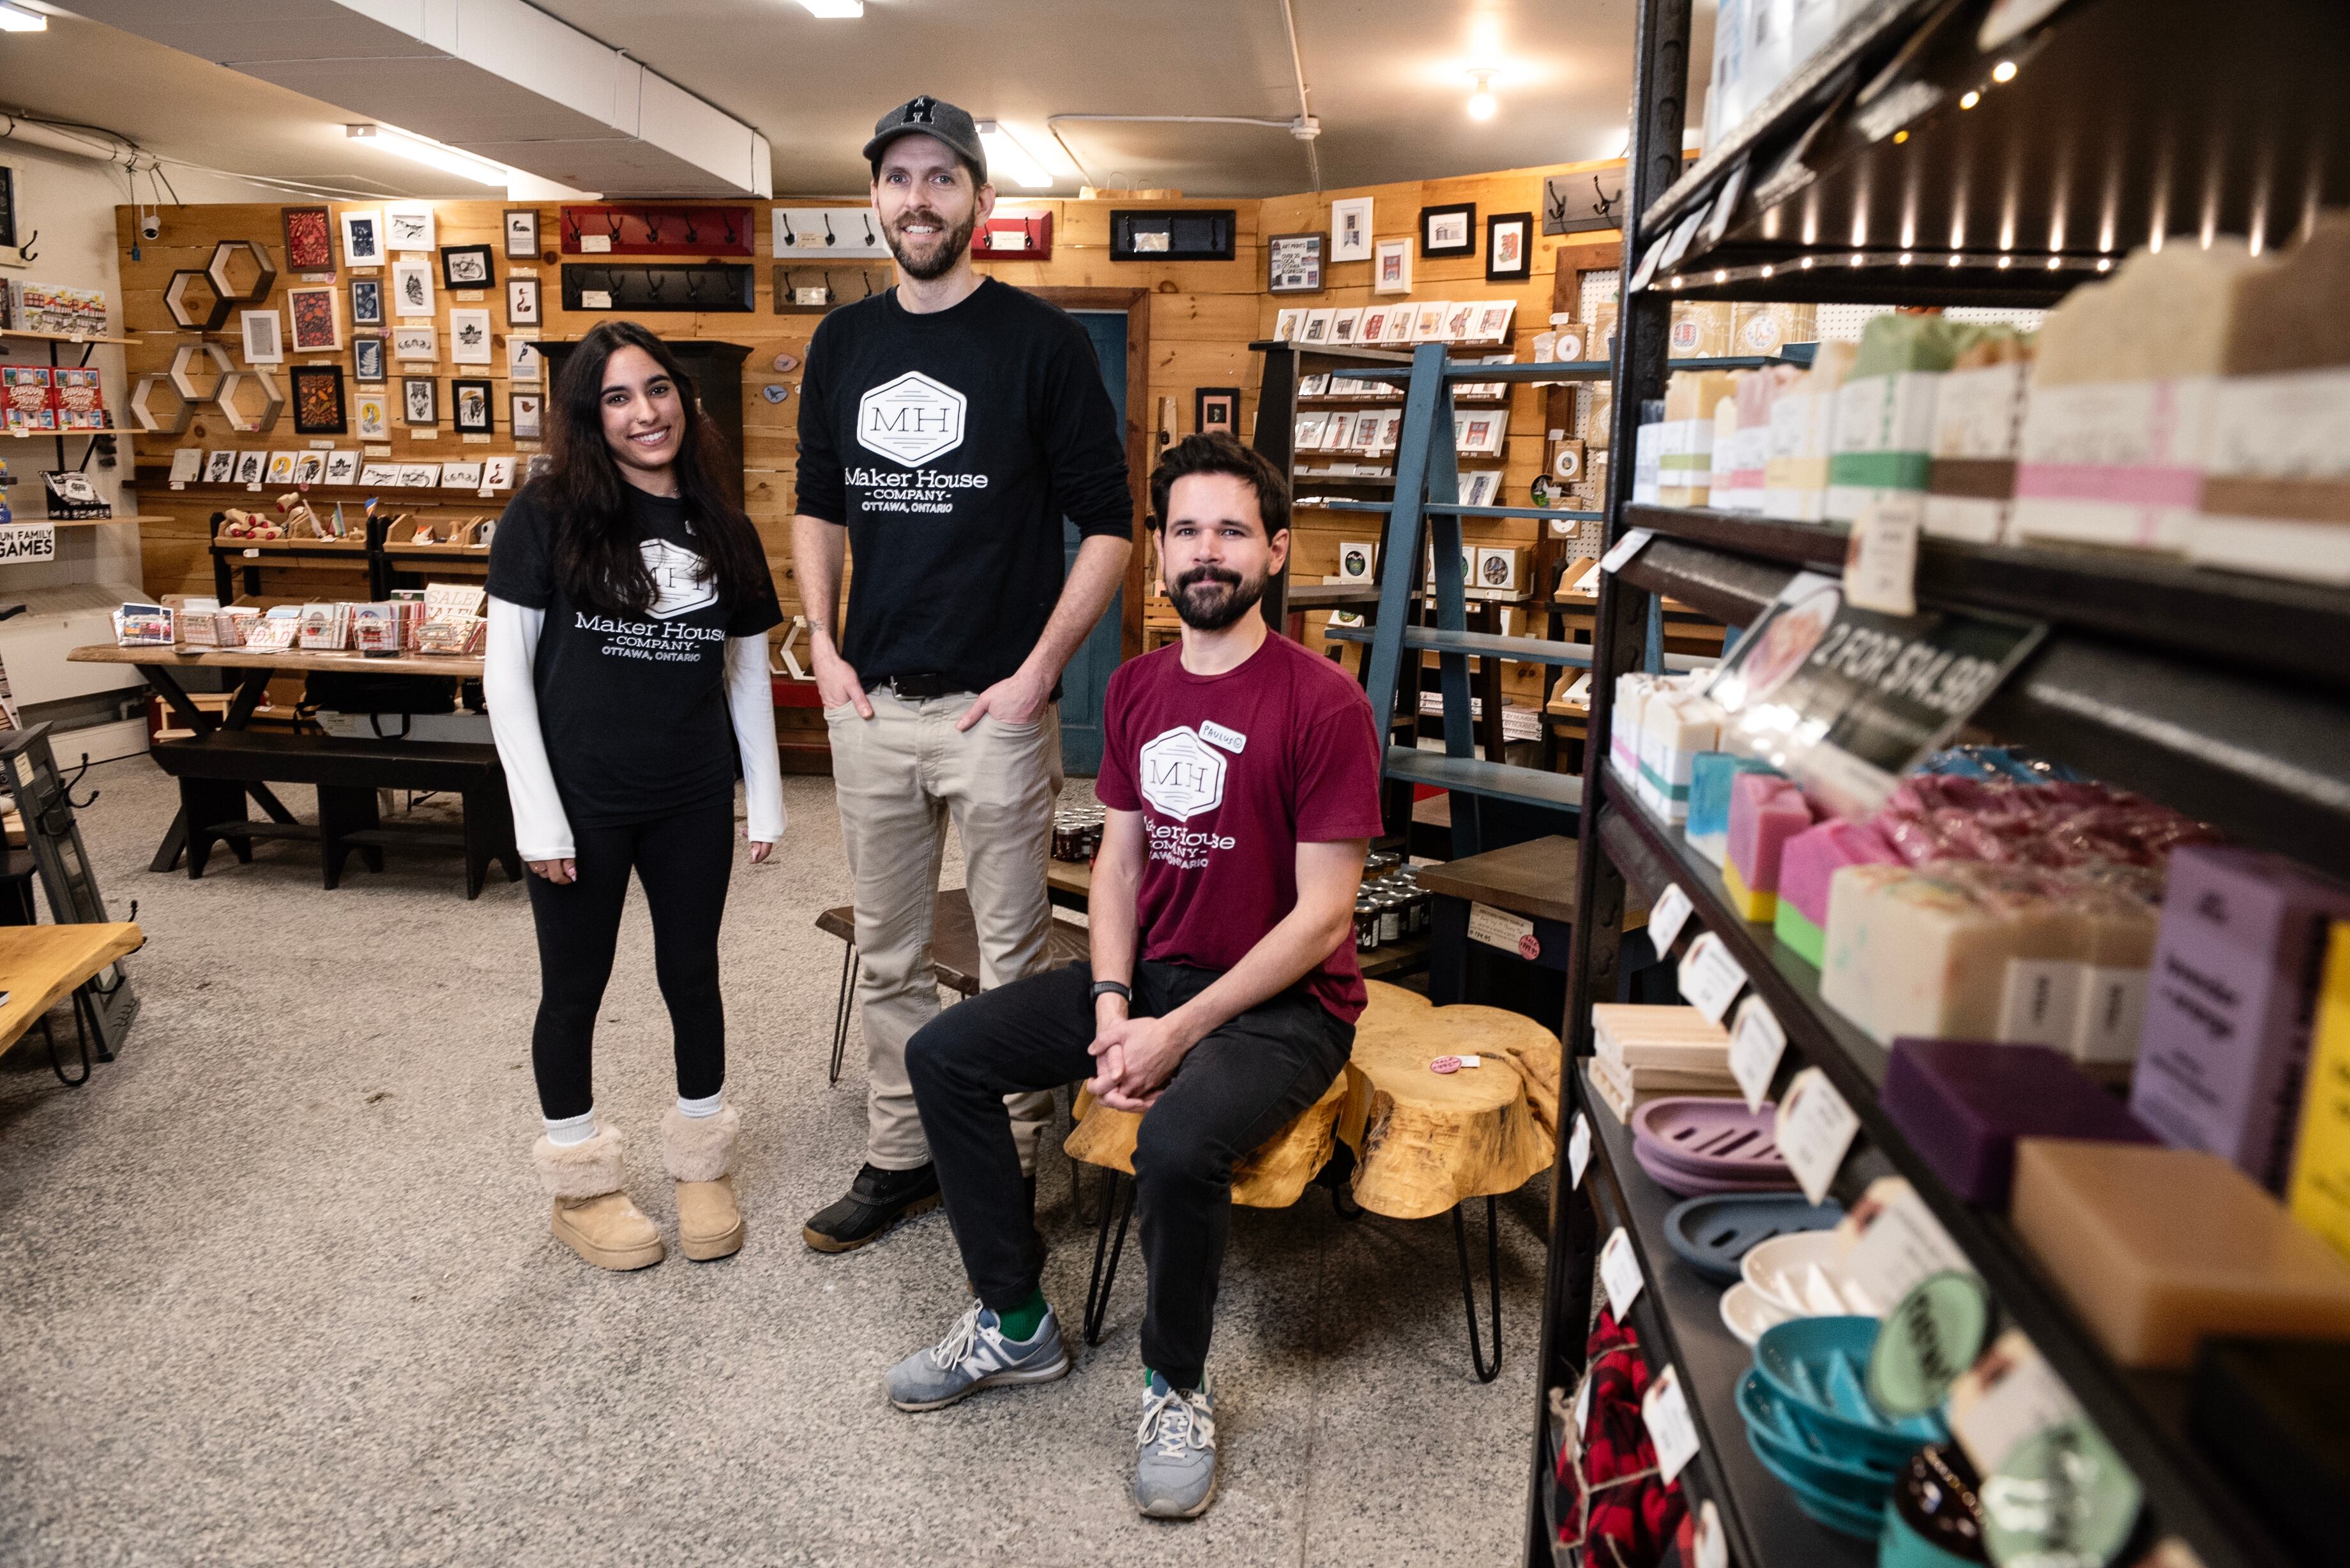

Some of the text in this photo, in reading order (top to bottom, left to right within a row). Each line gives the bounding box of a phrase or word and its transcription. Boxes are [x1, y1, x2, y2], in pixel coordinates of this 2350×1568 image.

[870, 407, 950, 432] MH
[845, 467, 989, 488] Maker House
[861, 501, 953, 513] OTTAWA, ONTARIO
[18, 529, 52, 540] FAMILY
[575, 611, 658, 637] Maker
[602, 646, 701, 662] OTTAWA, ONTARIO
[1203, 725, 1234, 745] PAULUS
[1149, 759, 1208, 794] MH
